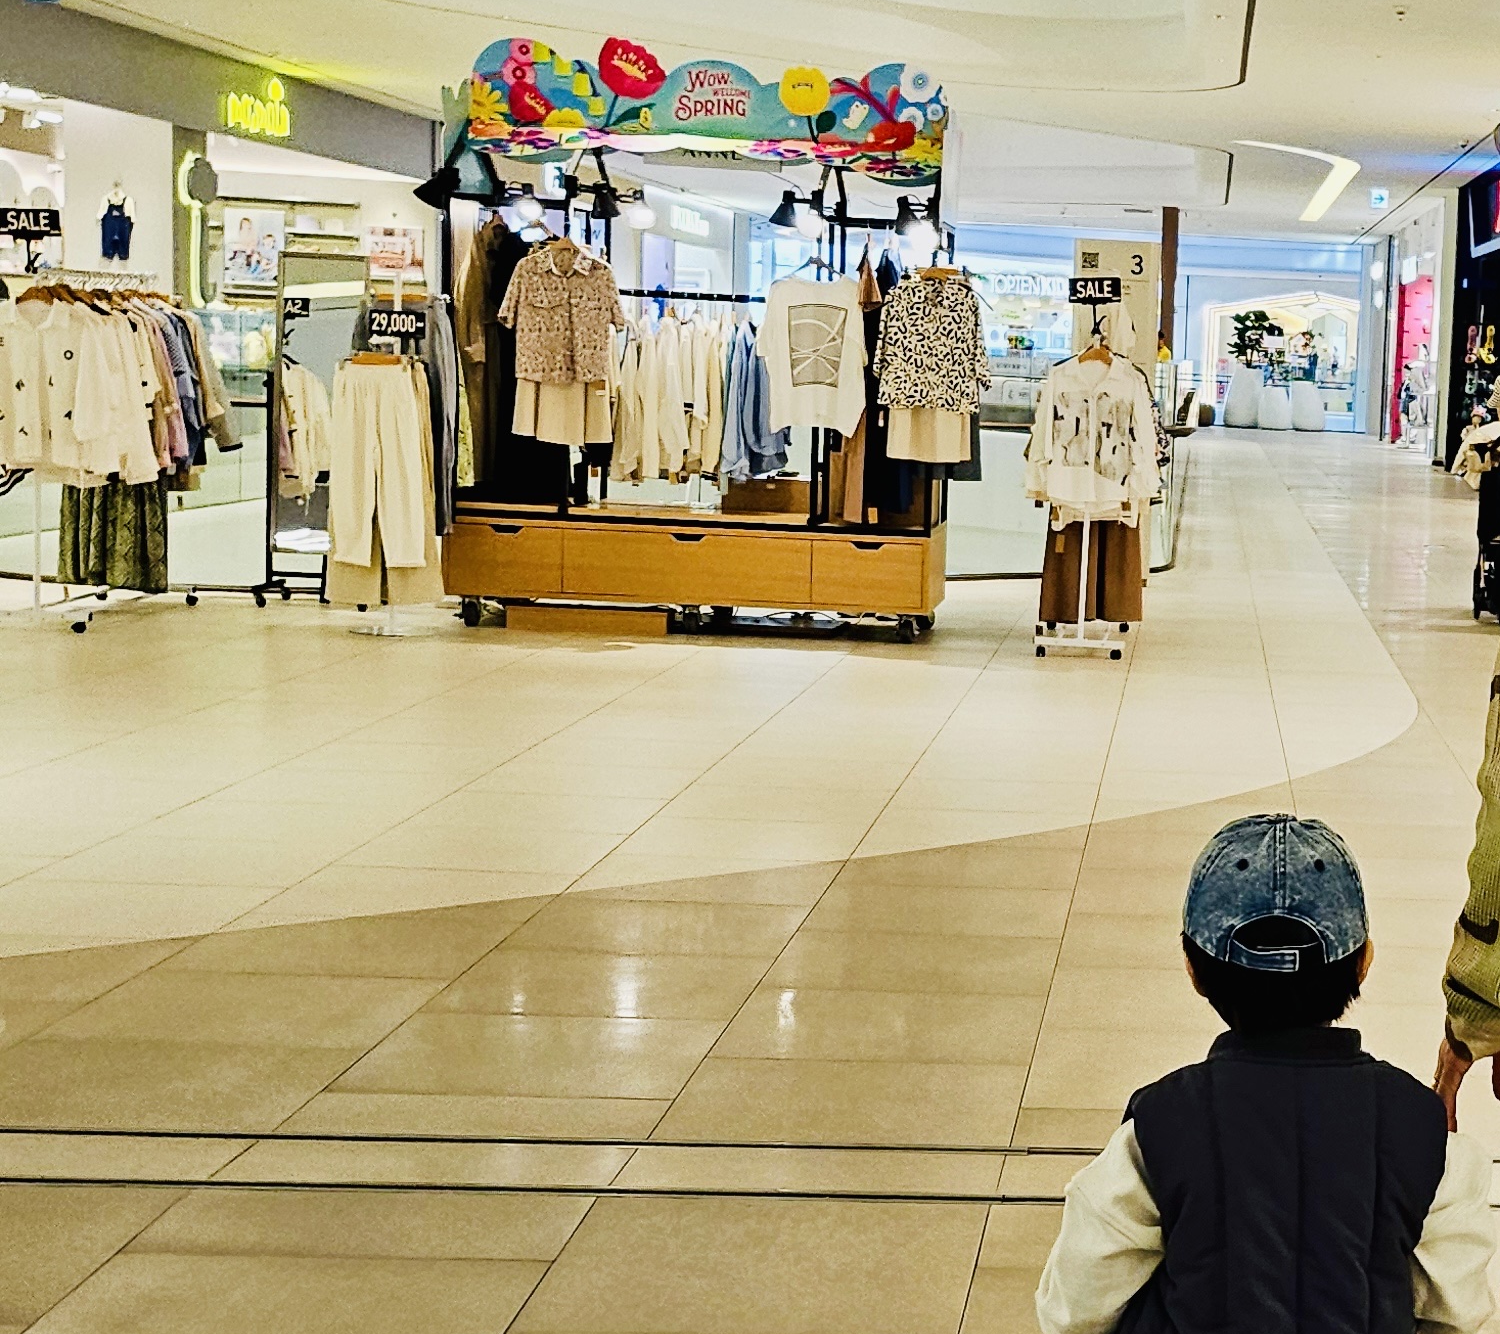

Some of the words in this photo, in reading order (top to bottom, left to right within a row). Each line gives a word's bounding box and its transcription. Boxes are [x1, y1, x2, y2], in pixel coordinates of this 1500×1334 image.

[6, 211, 51, 230] SALE
[1130, 254, 1144, 276] 3
[1075, 280, 1113, 299] SALE
